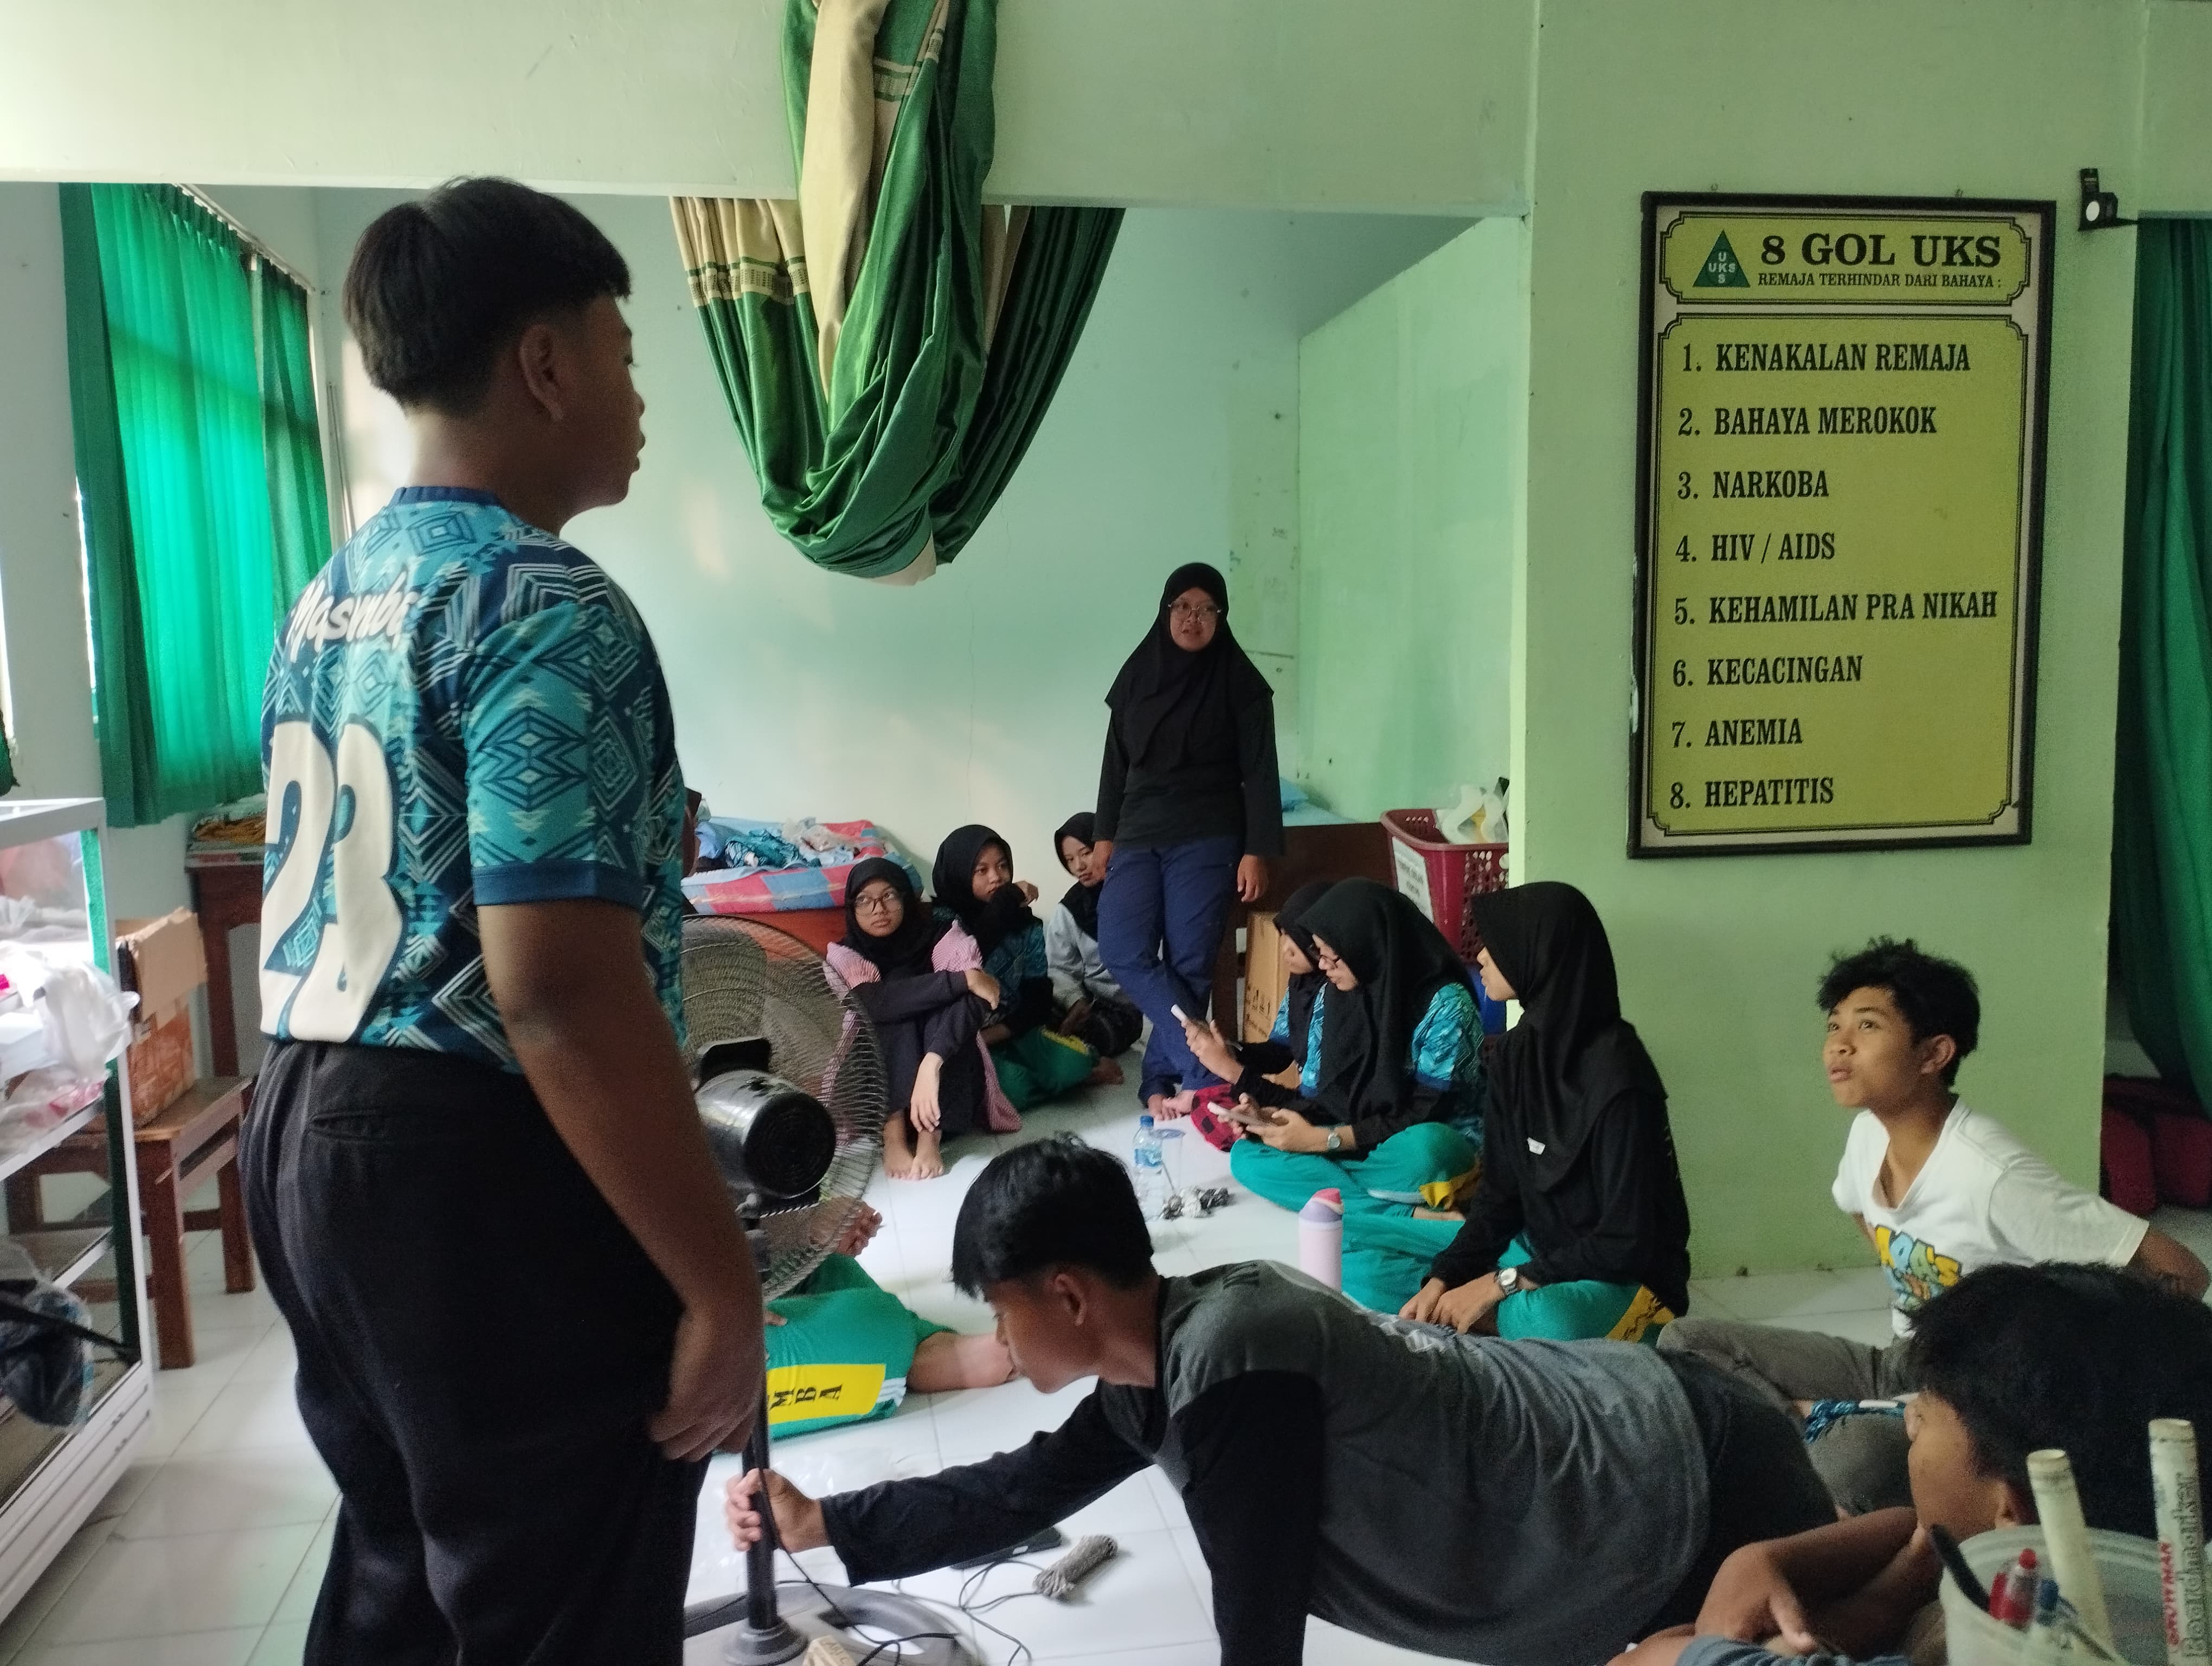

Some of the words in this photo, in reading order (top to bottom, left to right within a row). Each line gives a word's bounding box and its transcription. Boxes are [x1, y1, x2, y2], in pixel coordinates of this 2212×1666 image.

[1761, 235, 1785, 265] 8
[1802, 233, 1895, 265] GOL
[1911, 235, 2001, 268] UKS
[1708, 262, 1735, 273] UKS
[1758, 273, 1815, 286] REMAJA
[1819, 273, 1900, 286] TERHINDAR
[1905, 273, 1938, 287] DARI
[1942, 274, 1994, 287] BAHAYA
[1683, 343, 1701, 371] 1.
[1716, 344, 1867, 371] KENAKALAN
[1875, 344, 1971, 371] REMAJA
[1678, 408, 1700, 436] 2.
[1714, 407, 1810, 435] BAHAYA
[1818, 406, 1937, 434] MEROKOK
[1677, 471, 1698, 499] 3.
[1713, 470, 1829, 498] NARKOBA
[1675, 535, 1696, 562] 4.
[1711, 534, 1755, 561] HIV
[1778, 532, 1835, 560] AIDS
[1675, 597, 1695, 625] 5.
[1709, 594, 1858, 623] KEHAMILAN
[1866, 593, 1915, 620] PRA
[1922, 591, 1997, 619] NIKAH
[1673, 659, 1693, 687] 6.
[1707, 656, 1862, 685] KECACINGAN
[1672, 721, 1692, 748] 7.
[1705, 718, 1803, 746] ANEMIA
[1670, 782, 1690, 809] 8.
[1705, 777, 1834, 807] HEPATITIS
[767, 1383, 843, 1411] MBA
